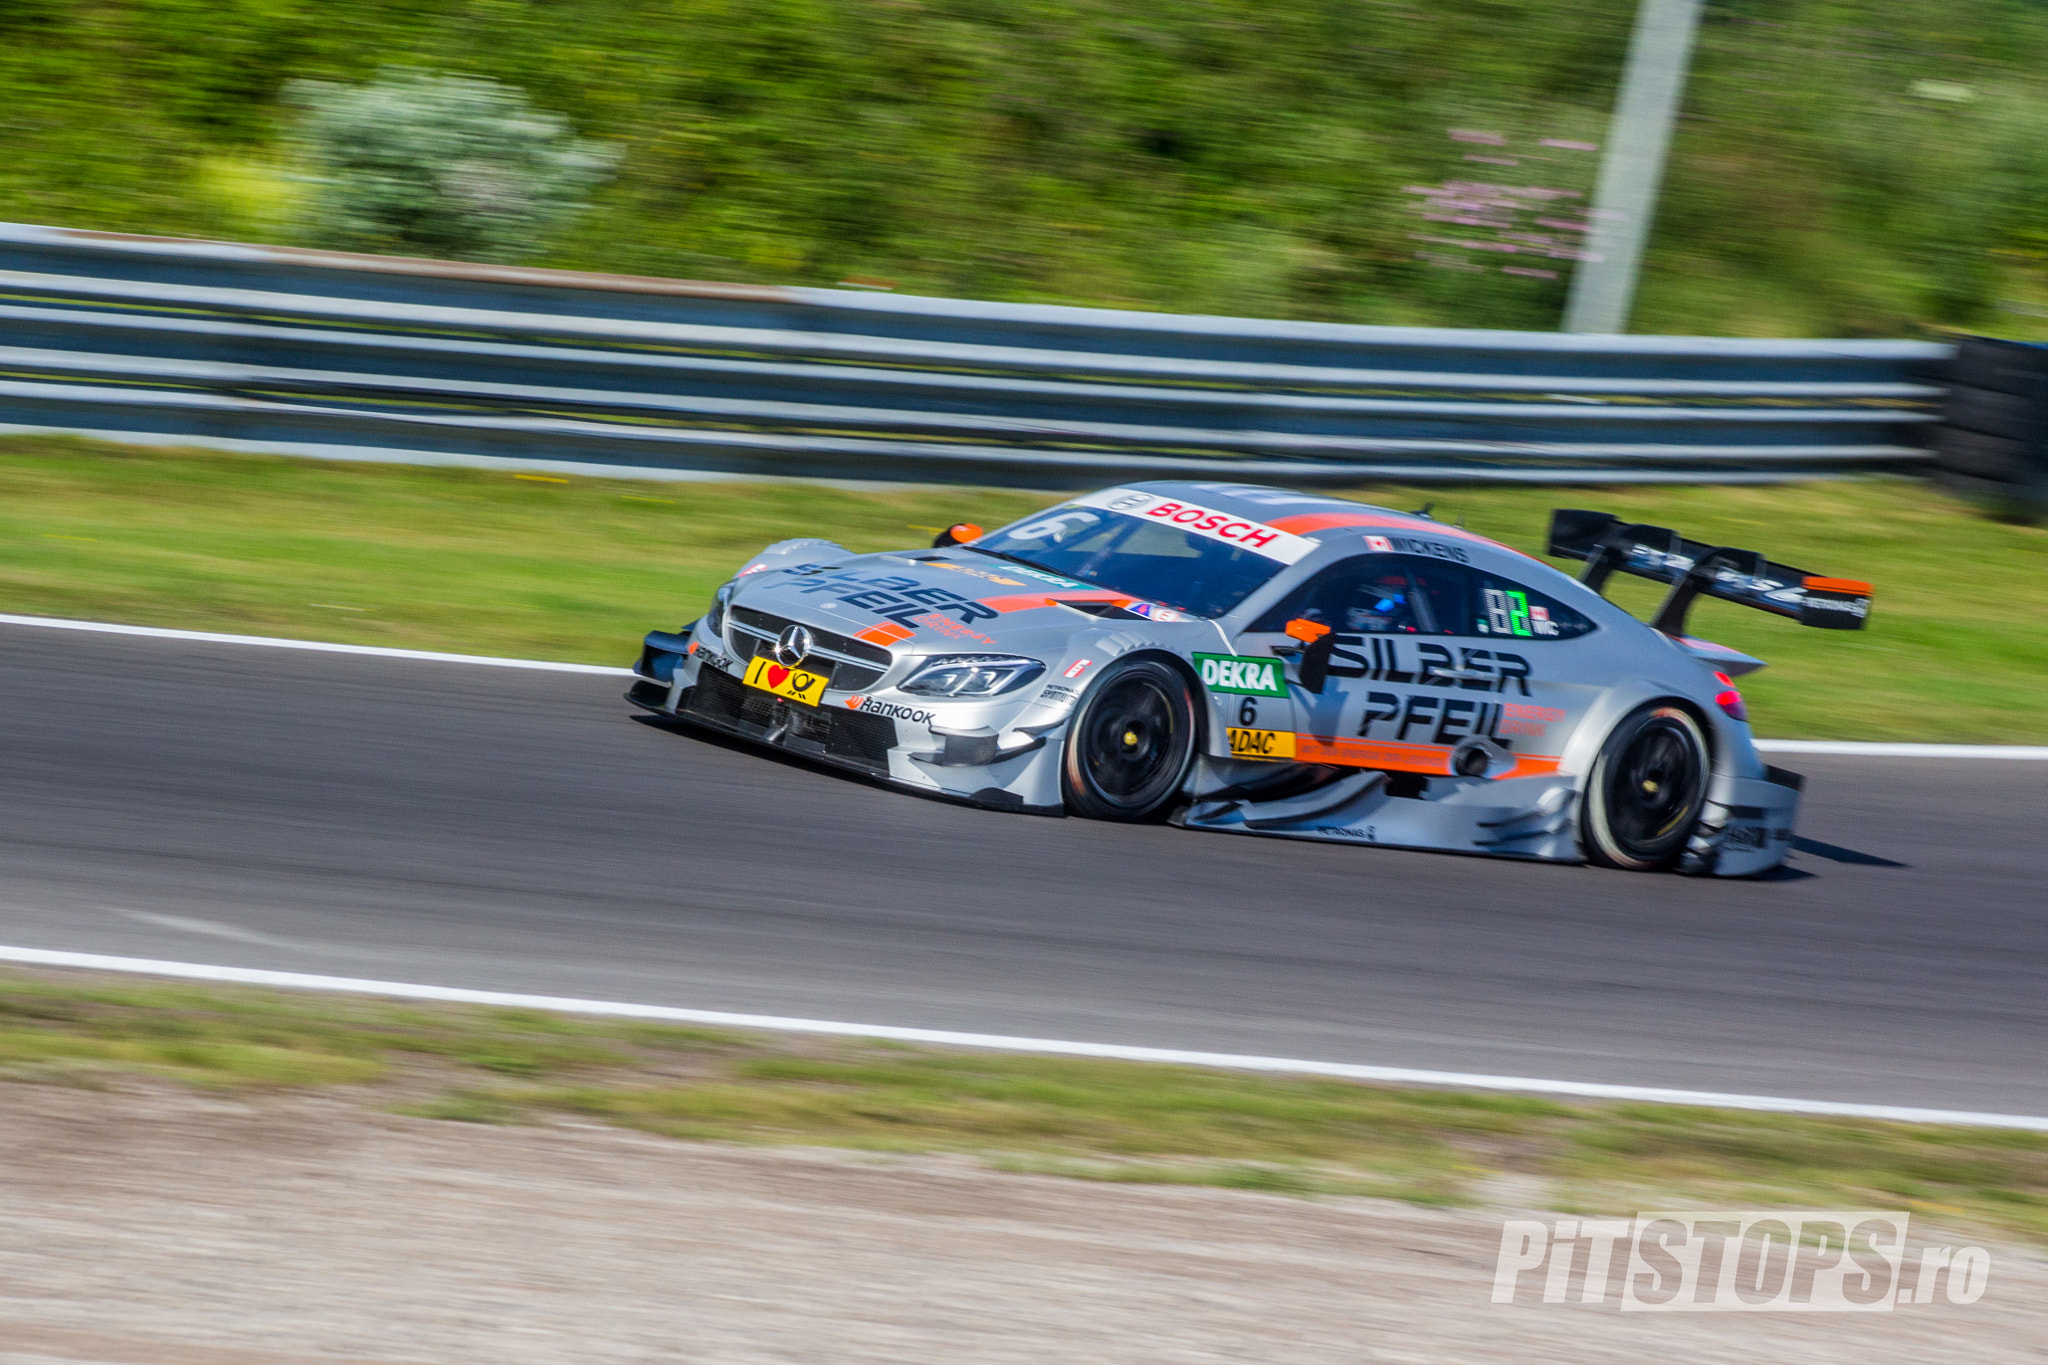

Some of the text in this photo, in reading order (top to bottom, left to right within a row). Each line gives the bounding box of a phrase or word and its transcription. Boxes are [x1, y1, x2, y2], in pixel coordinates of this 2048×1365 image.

[1007, 512, 1101, 541] 6
[1146, 502, 1280, 548] BOSCH
[763, 578, 920, 629] PFEIL
[782, 563, 999, 624] SILBER
[928, 613, 997, 645] ENERGY
[1063, 659, 1093, 679] 6
[1202, 658, 1278, 692] DEKRA
[1326, 633, 1533, 697] SILBER
[1239, 697, 1258, 726] 6
[1357, 691, 1514, 750] PFEIL
